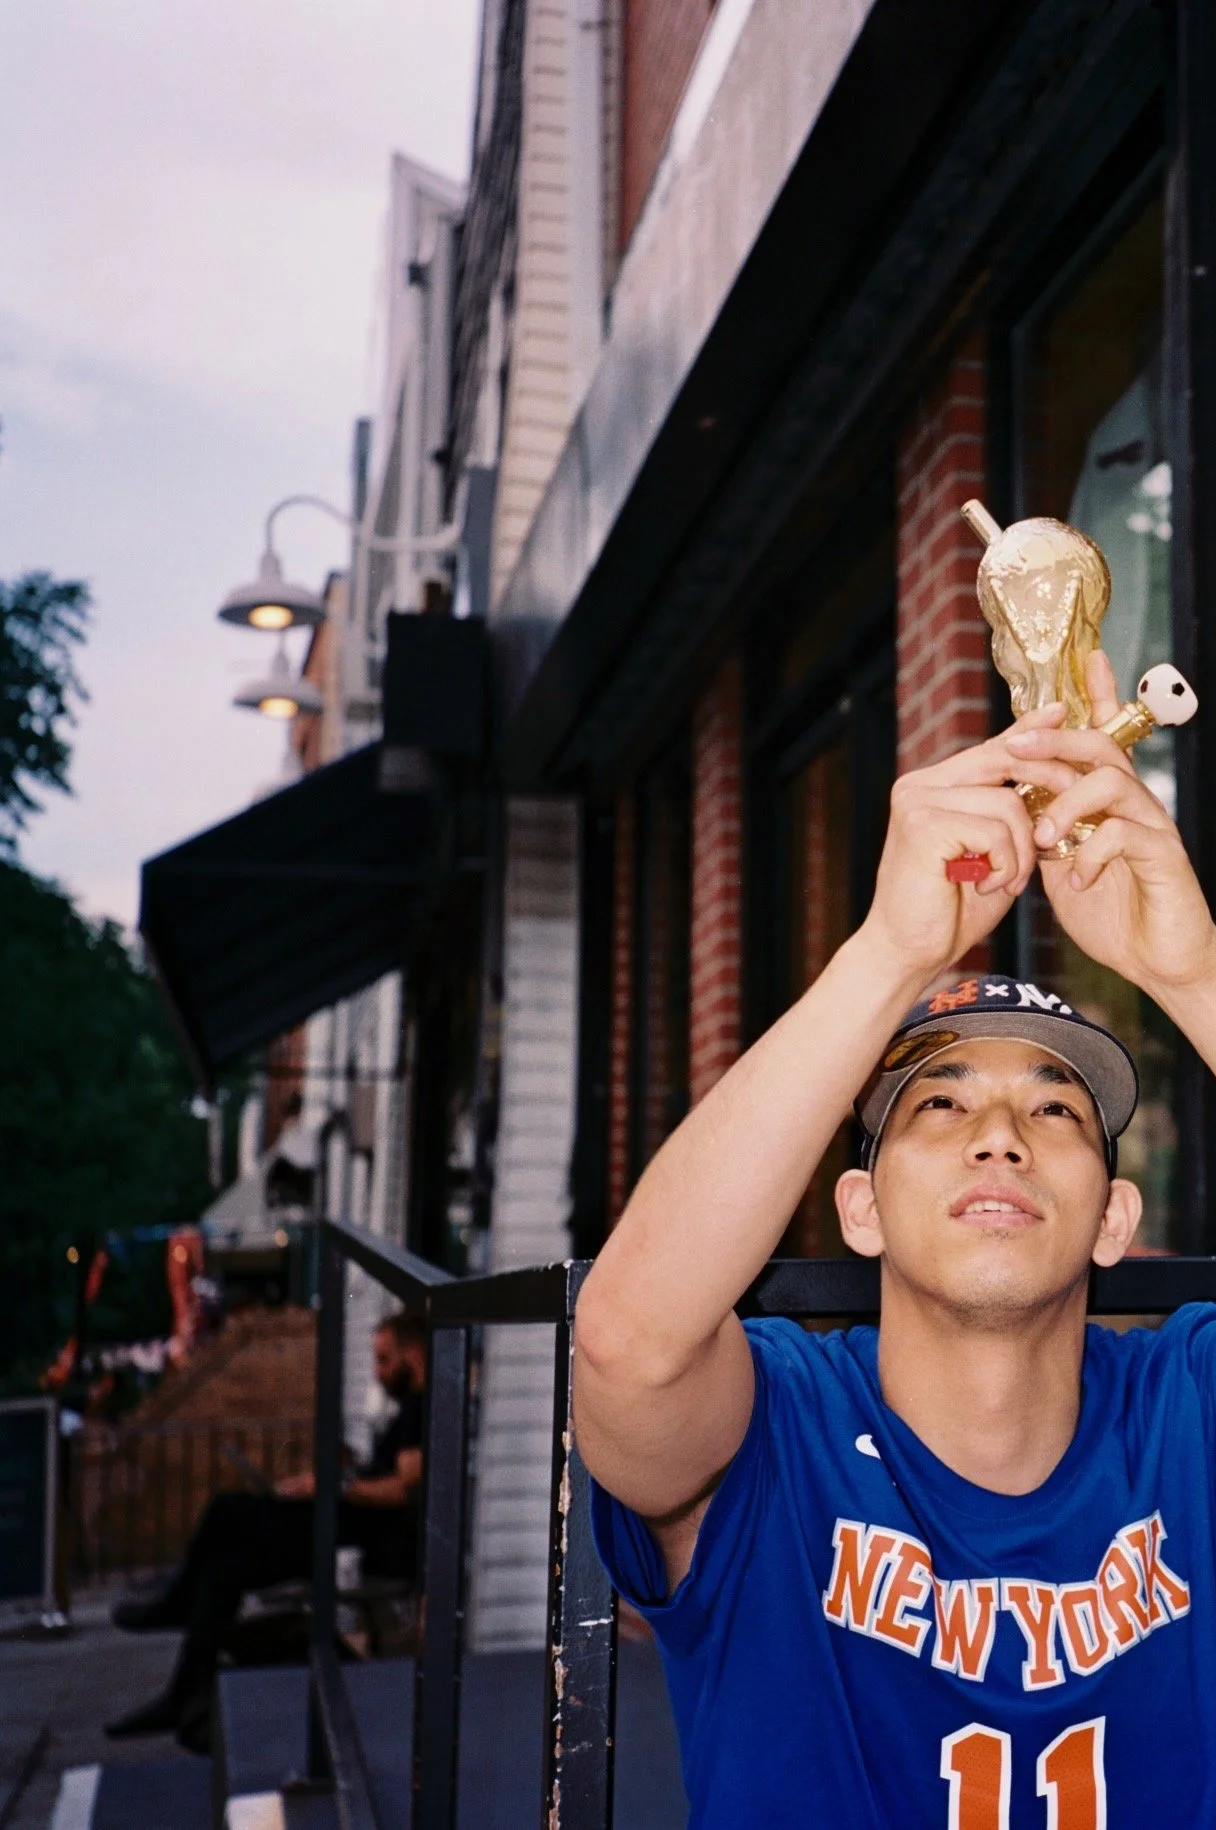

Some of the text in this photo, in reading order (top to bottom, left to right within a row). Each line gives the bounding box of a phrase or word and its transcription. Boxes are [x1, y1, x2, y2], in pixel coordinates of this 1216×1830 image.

[822, 1509, 1191, 1692] NEW YORK
[940, 1715, 1107, 1830] 11
